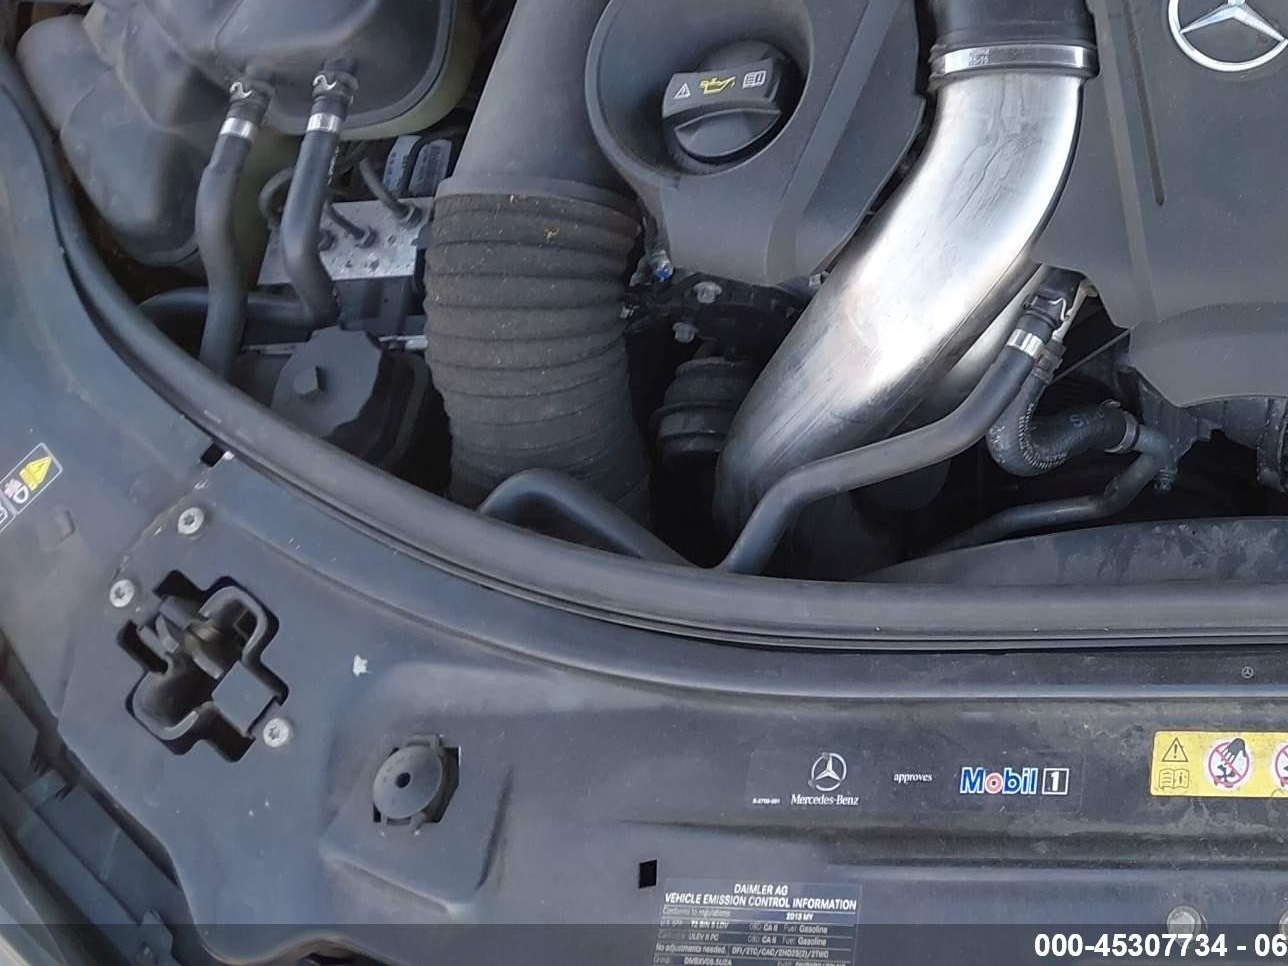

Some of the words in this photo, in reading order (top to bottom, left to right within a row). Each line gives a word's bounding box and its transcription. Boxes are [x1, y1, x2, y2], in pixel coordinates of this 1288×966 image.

[893, 773, 933, 784] approves
[960, 767, 1038, 794] Mobil
[791, 793, 860, 806] Mercedes-Benz
[733, 884, 773, 895] DAIMLER
[774, 885, 789, 896] AG
[665, 893, 702, 904] VEHICLE
[703, 894, 749, 906] EMISSION
[748, 896, 791, 908] CONTROL
[792, 897, 857, 911] INFORMATION
